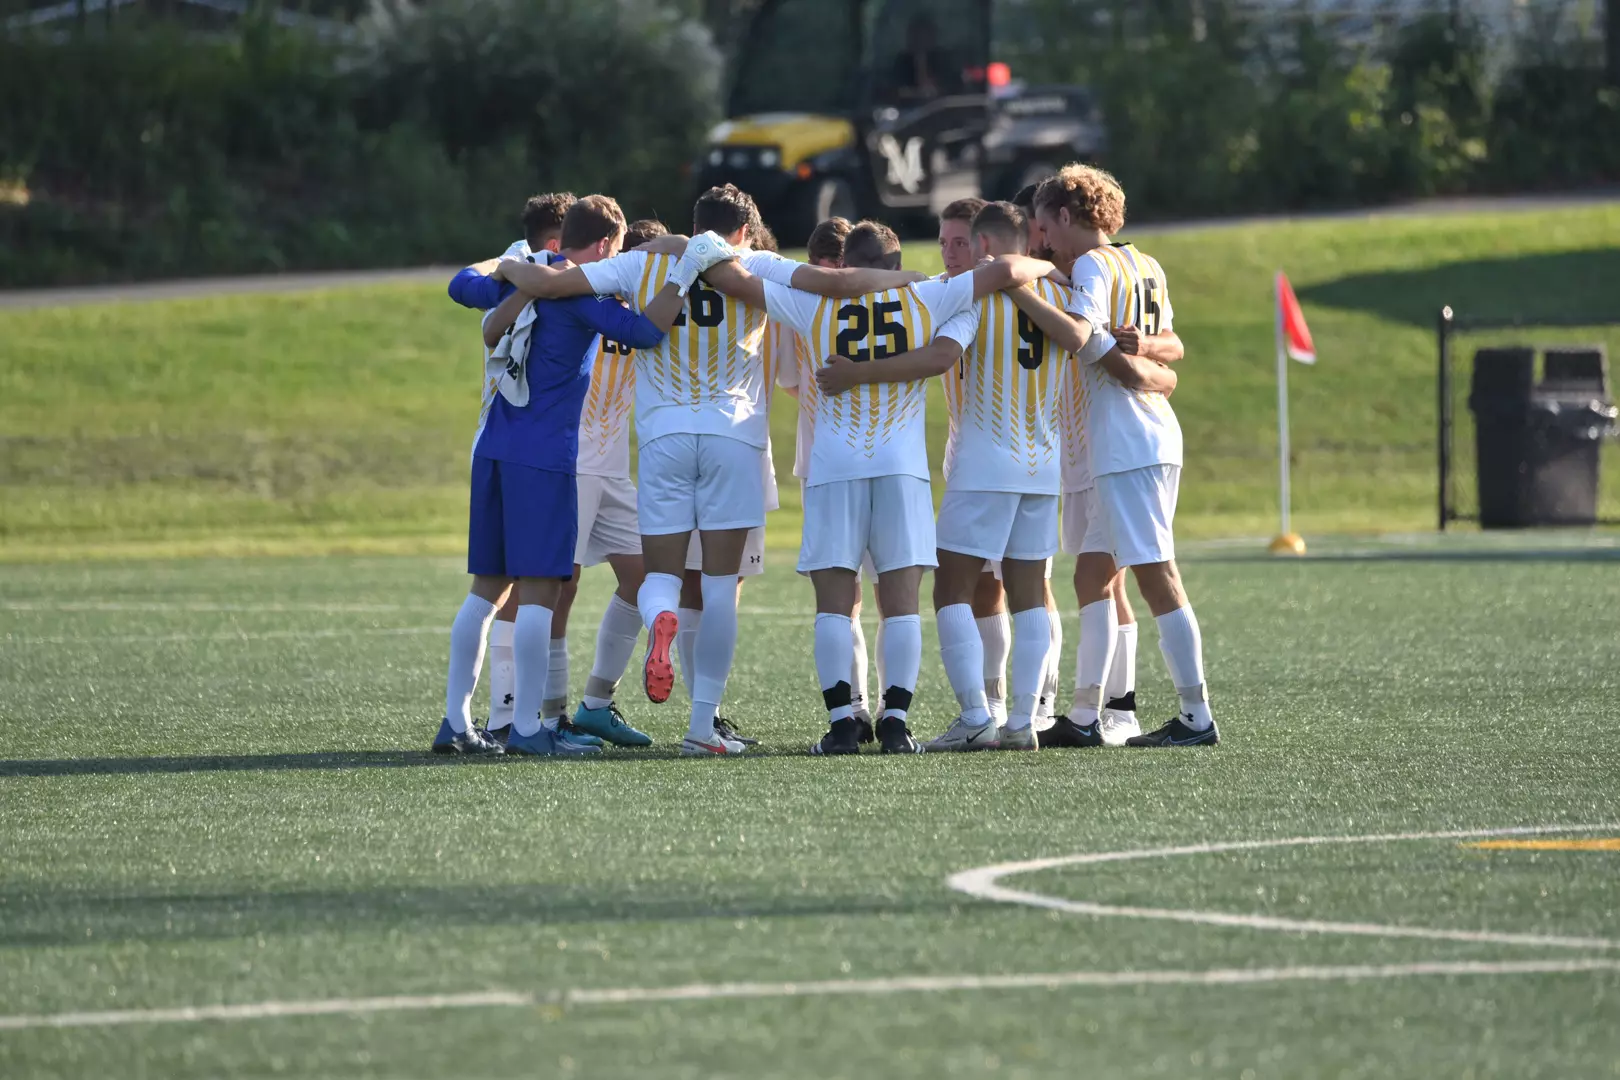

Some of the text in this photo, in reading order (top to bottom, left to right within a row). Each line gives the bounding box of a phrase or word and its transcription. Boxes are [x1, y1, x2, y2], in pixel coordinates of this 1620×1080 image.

[671, 275, 725, 327] 6
[1133, 278, 1160, 335] 15
[836, 301, 908, 362] 25
[1017, 307, 1043, 370] 9
